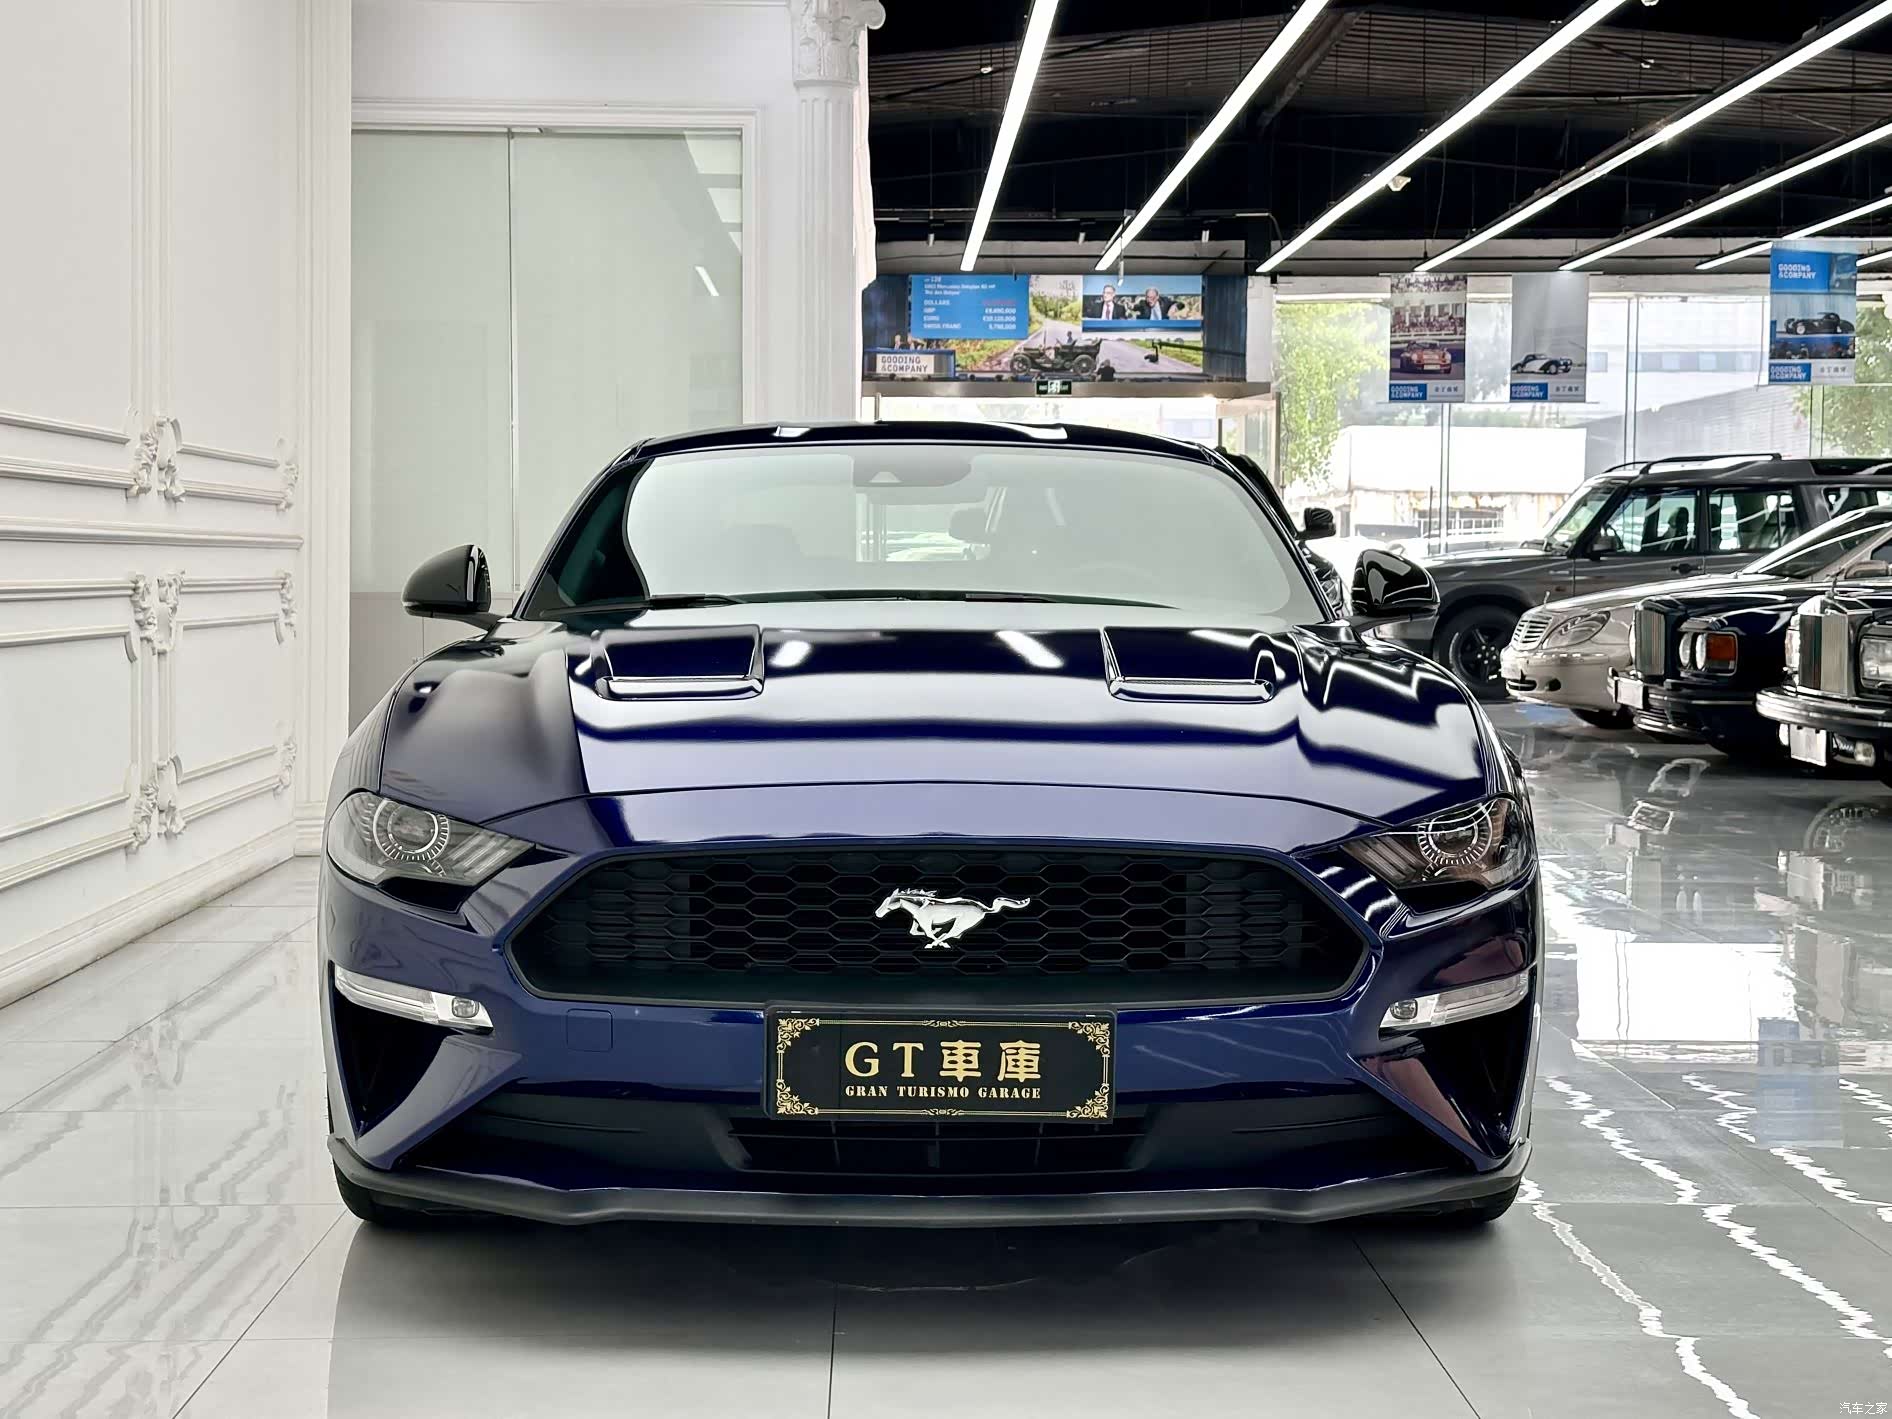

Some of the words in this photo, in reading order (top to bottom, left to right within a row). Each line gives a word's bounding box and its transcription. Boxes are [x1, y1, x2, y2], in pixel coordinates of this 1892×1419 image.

[1778, 263, 1811, 272] GOODING
[1778, 271, 1817, 280] &COMPANY
[881, 355, 922, 365] GOODING
[880, 364, 929, 373] &COMPANY
[1771, 365, 1802, 374] GOODING
[1511, 384, 1540, 392] GOODING
[845, 1085, 888, 1098] GRAN
[897, 1086, 970, 1099] TURISMO
[978, 1087, 1041, 1100] GARAGE
